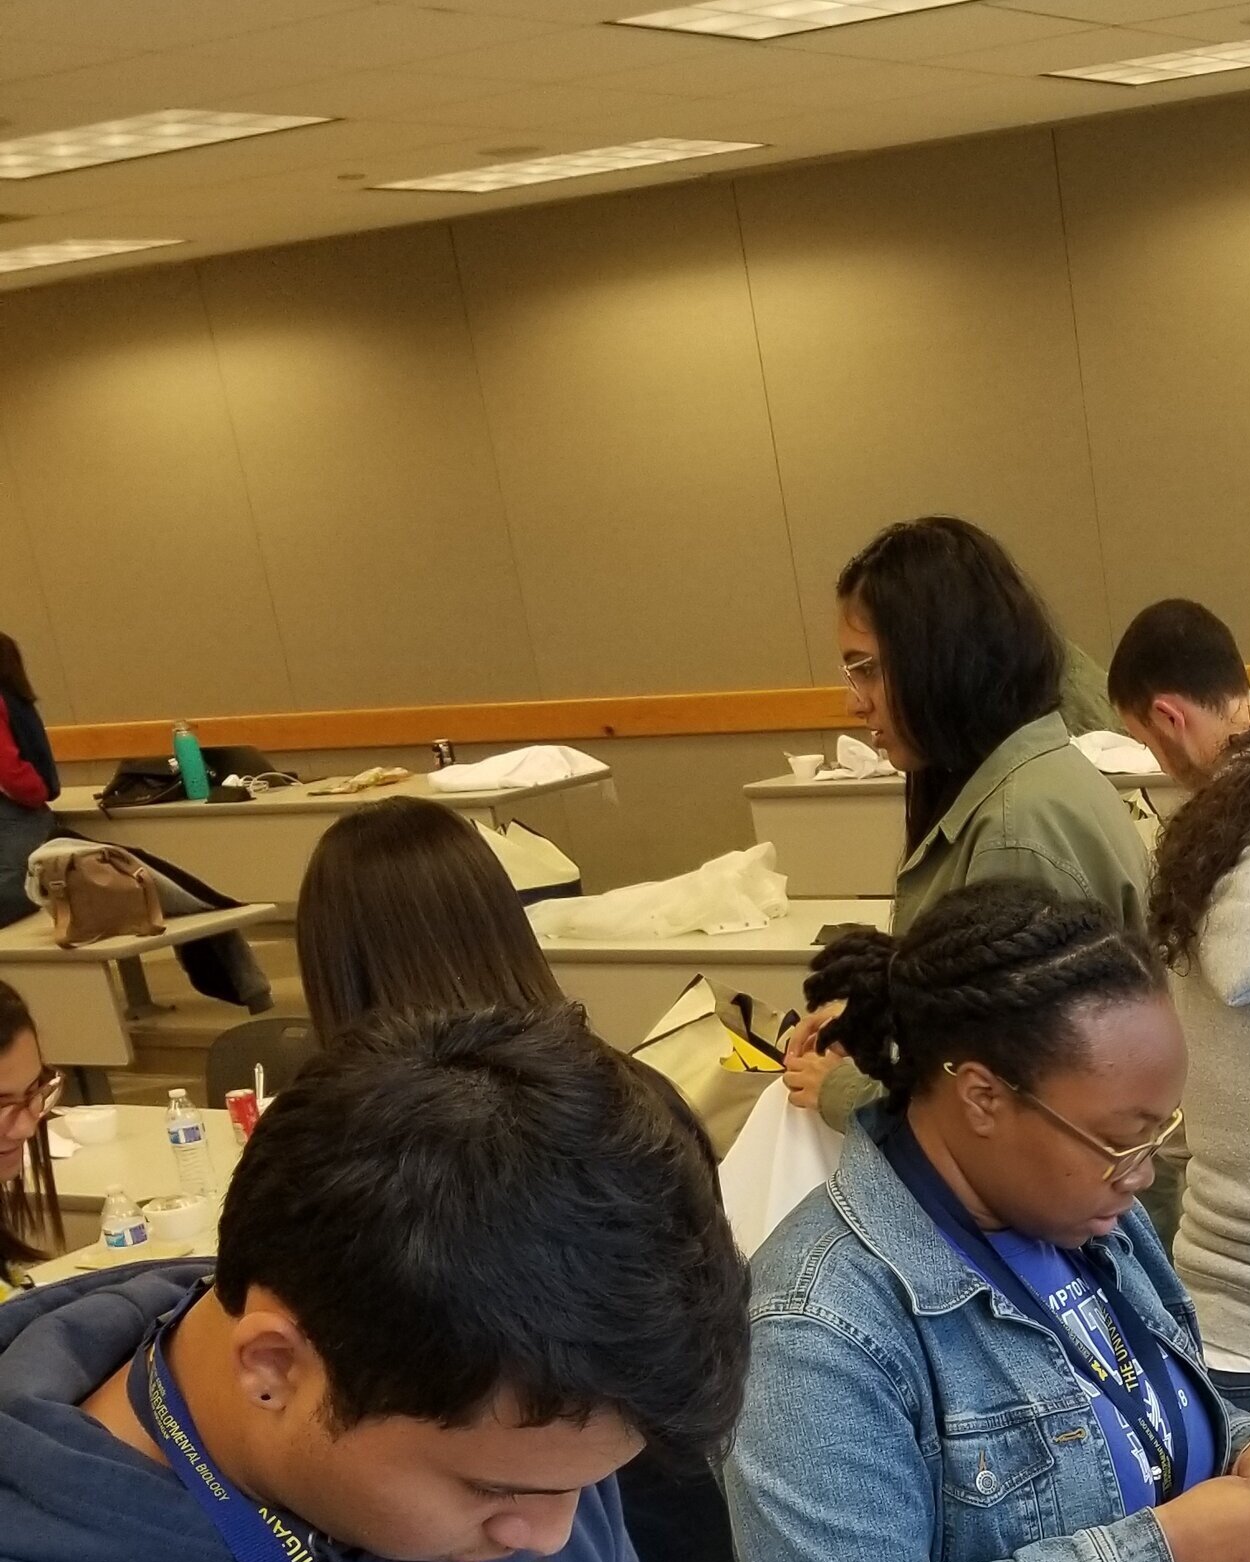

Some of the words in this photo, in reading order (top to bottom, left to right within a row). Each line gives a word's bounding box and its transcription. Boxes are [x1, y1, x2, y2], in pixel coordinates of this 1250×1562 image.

[1120, 1360, 1139, 1393] THE
[152, 1389, 201, 1466] DEVELOPMENTAL
[194, 1463, 230, 1502] BIOLOGY
